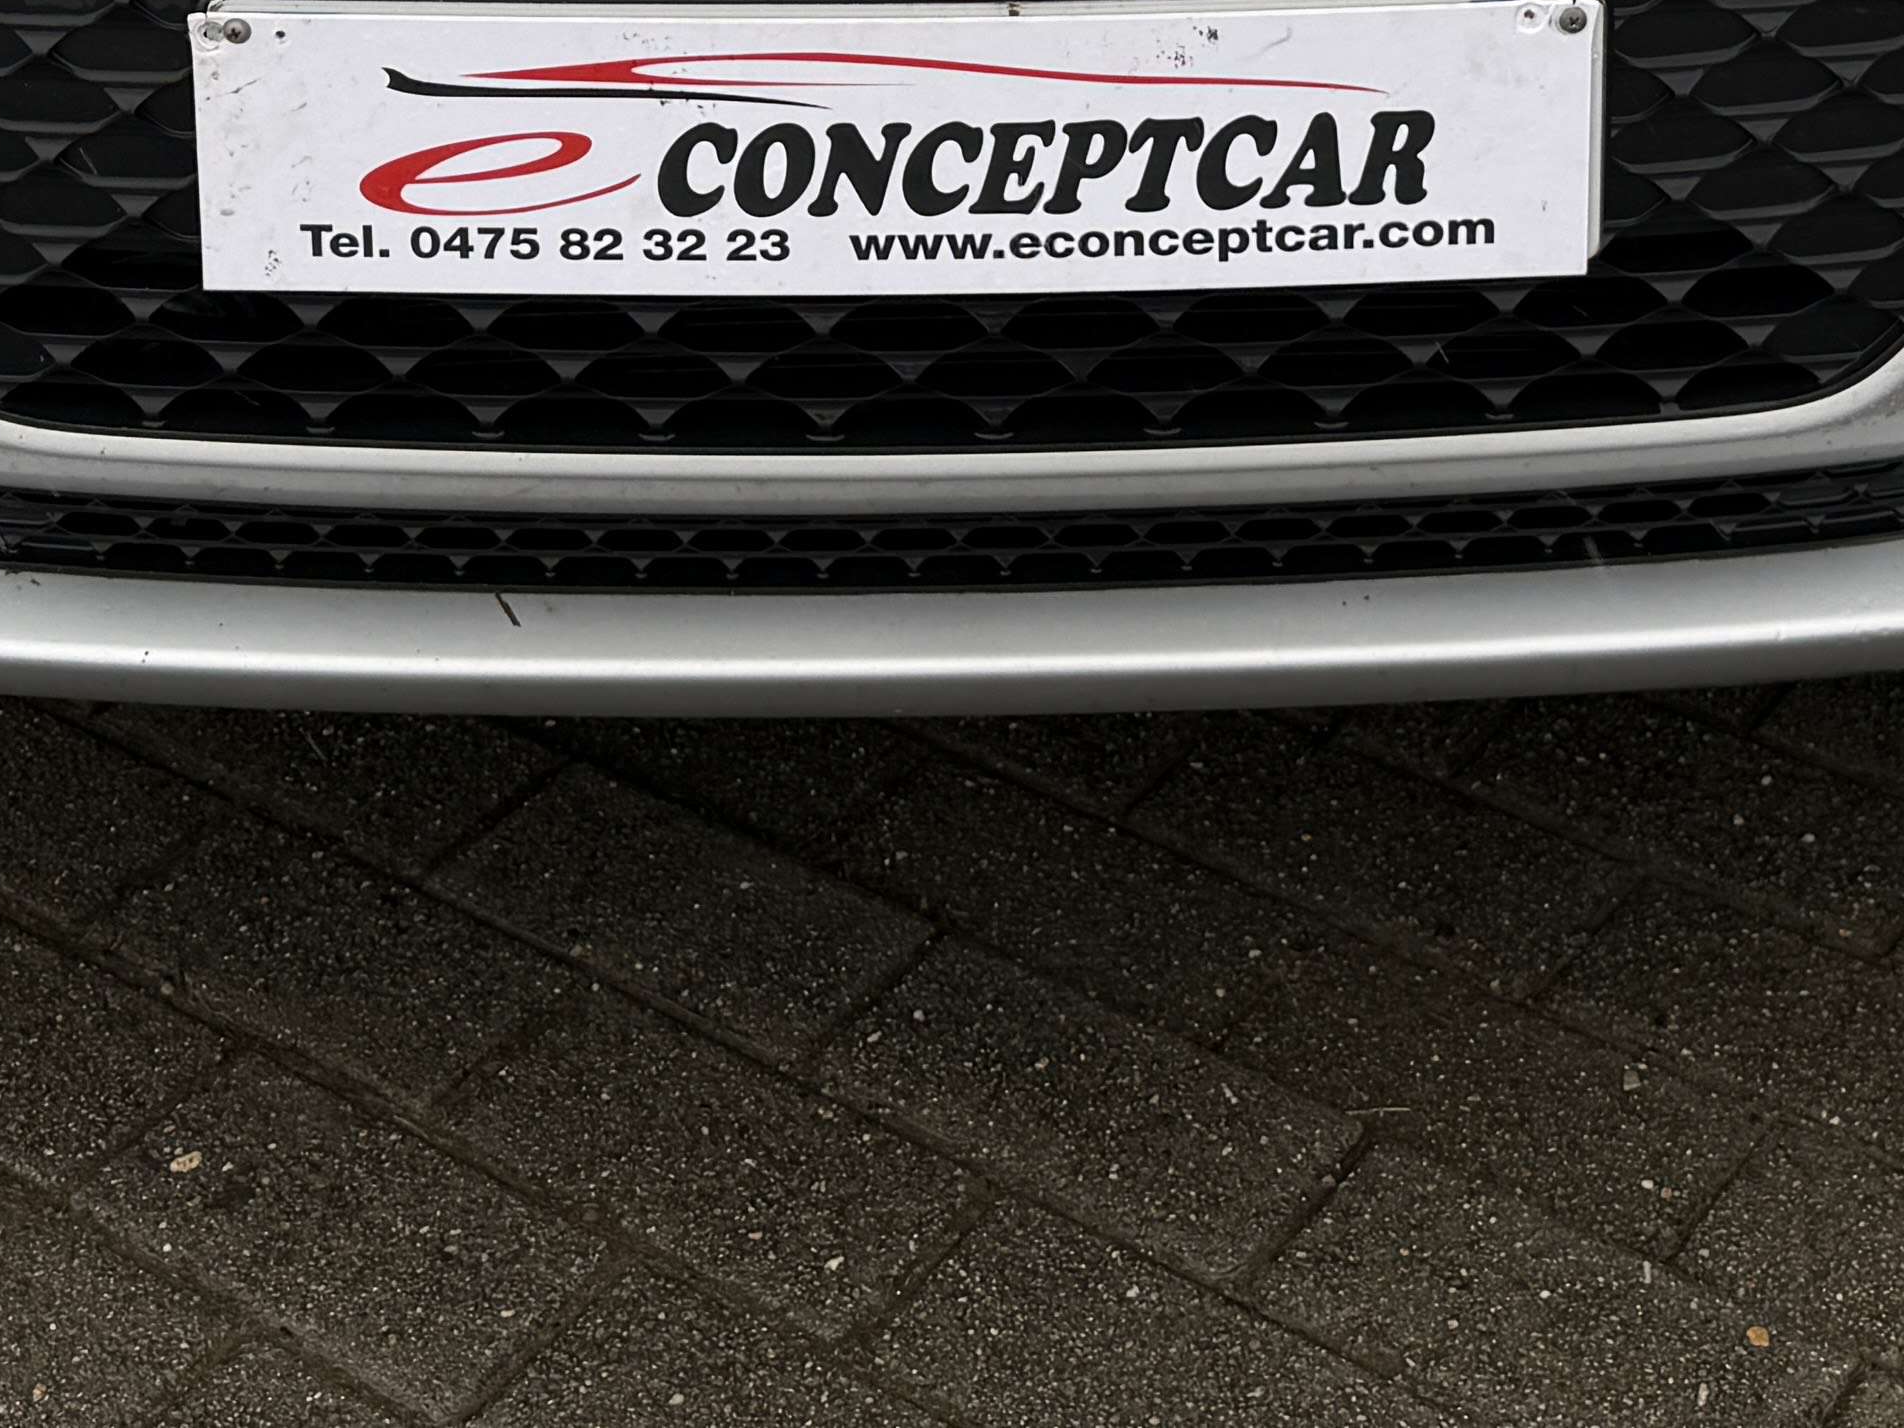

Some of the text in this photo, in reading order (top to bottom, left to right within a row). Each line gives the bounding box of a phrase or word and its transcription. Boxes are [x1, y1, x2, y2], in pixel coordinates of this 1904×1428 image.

[358, 109, 1436, 218] e CONCEPTCAR
[299, 215, 1496, 263] Tel. 0475 82 32 23 www.econceptcar.com
